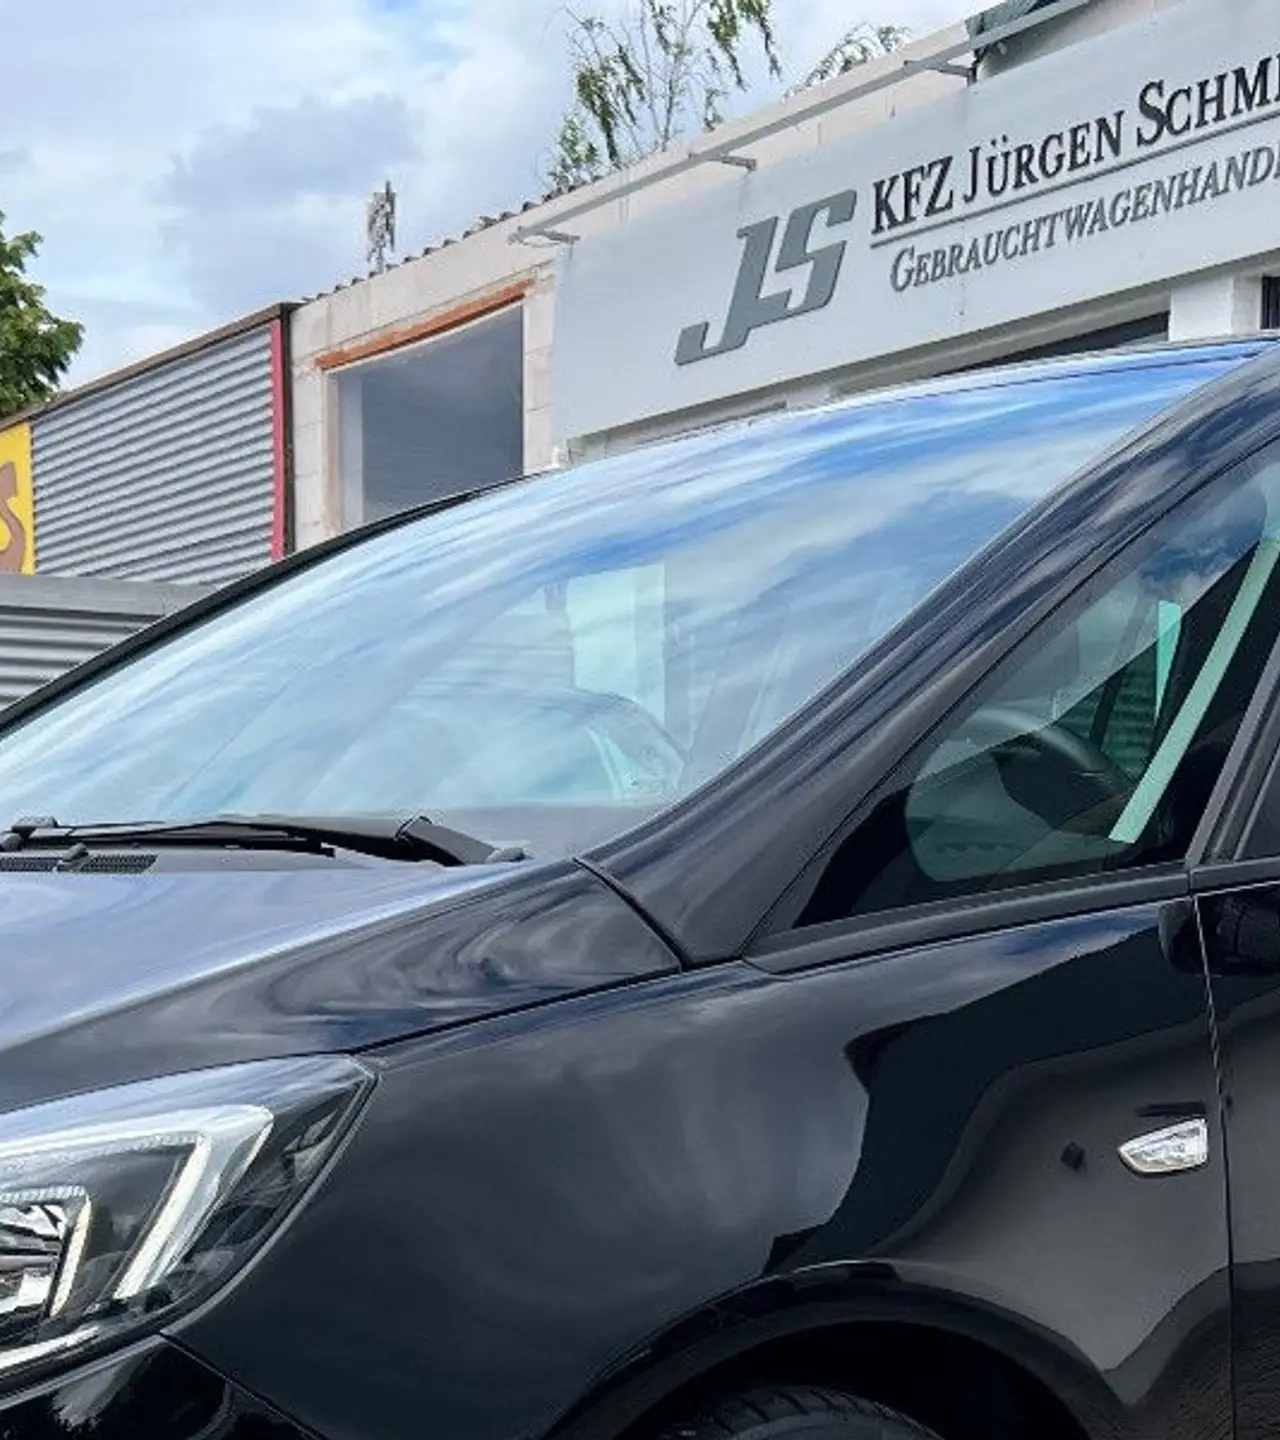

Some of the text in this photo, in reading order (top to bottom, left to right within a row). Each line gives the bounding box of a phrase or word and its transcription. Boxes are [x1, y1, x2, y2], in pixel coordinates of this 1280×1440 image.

[871, 155, 954, 236] KFZ
[963, 110, 1125, 204] JÜRGEN
[674, 189, 858, 366] JS
